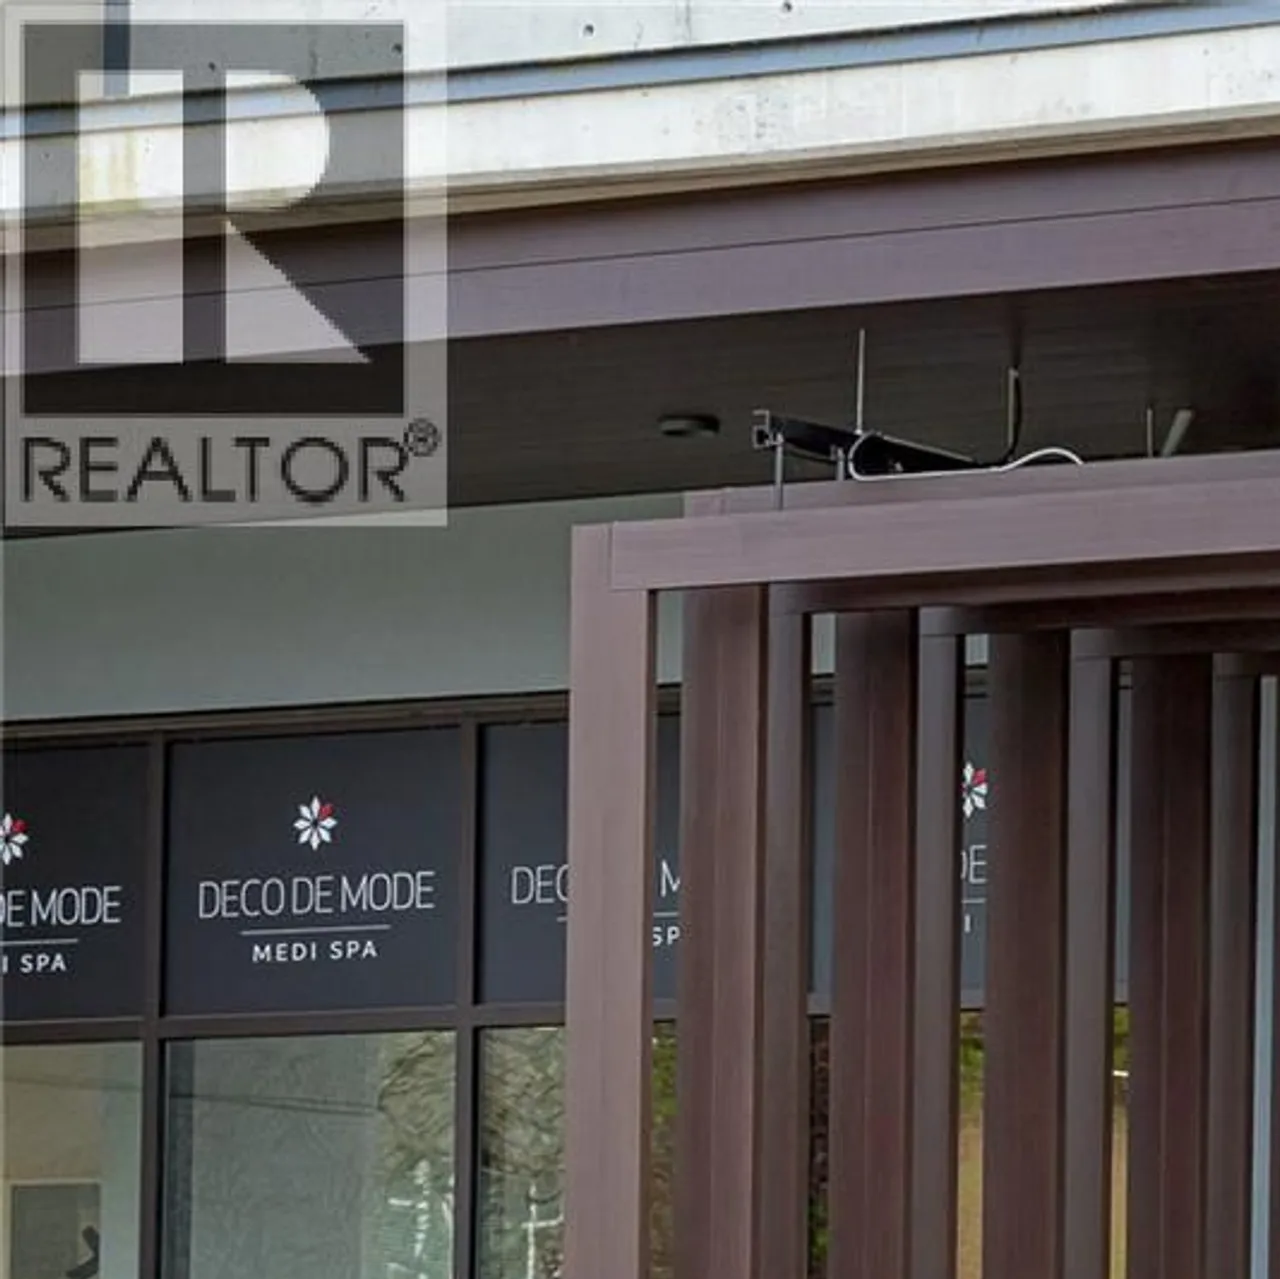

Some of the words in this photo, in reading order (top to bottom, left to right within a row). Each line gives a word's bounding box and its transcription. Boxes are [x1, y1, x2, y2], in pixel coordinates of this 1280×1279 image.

[198, 877, 286, 919] DECO
[292, 875, 334, 914] DE
[340, 870, 436, 913] MODE
[511, 863, 570, 905] DEC
[30, 885, 122, 926] MODE
[19, 952, 67, 974] SPA
[252, 942, 317, 963] MEDI
[329, 939, 379, 960] SPA
